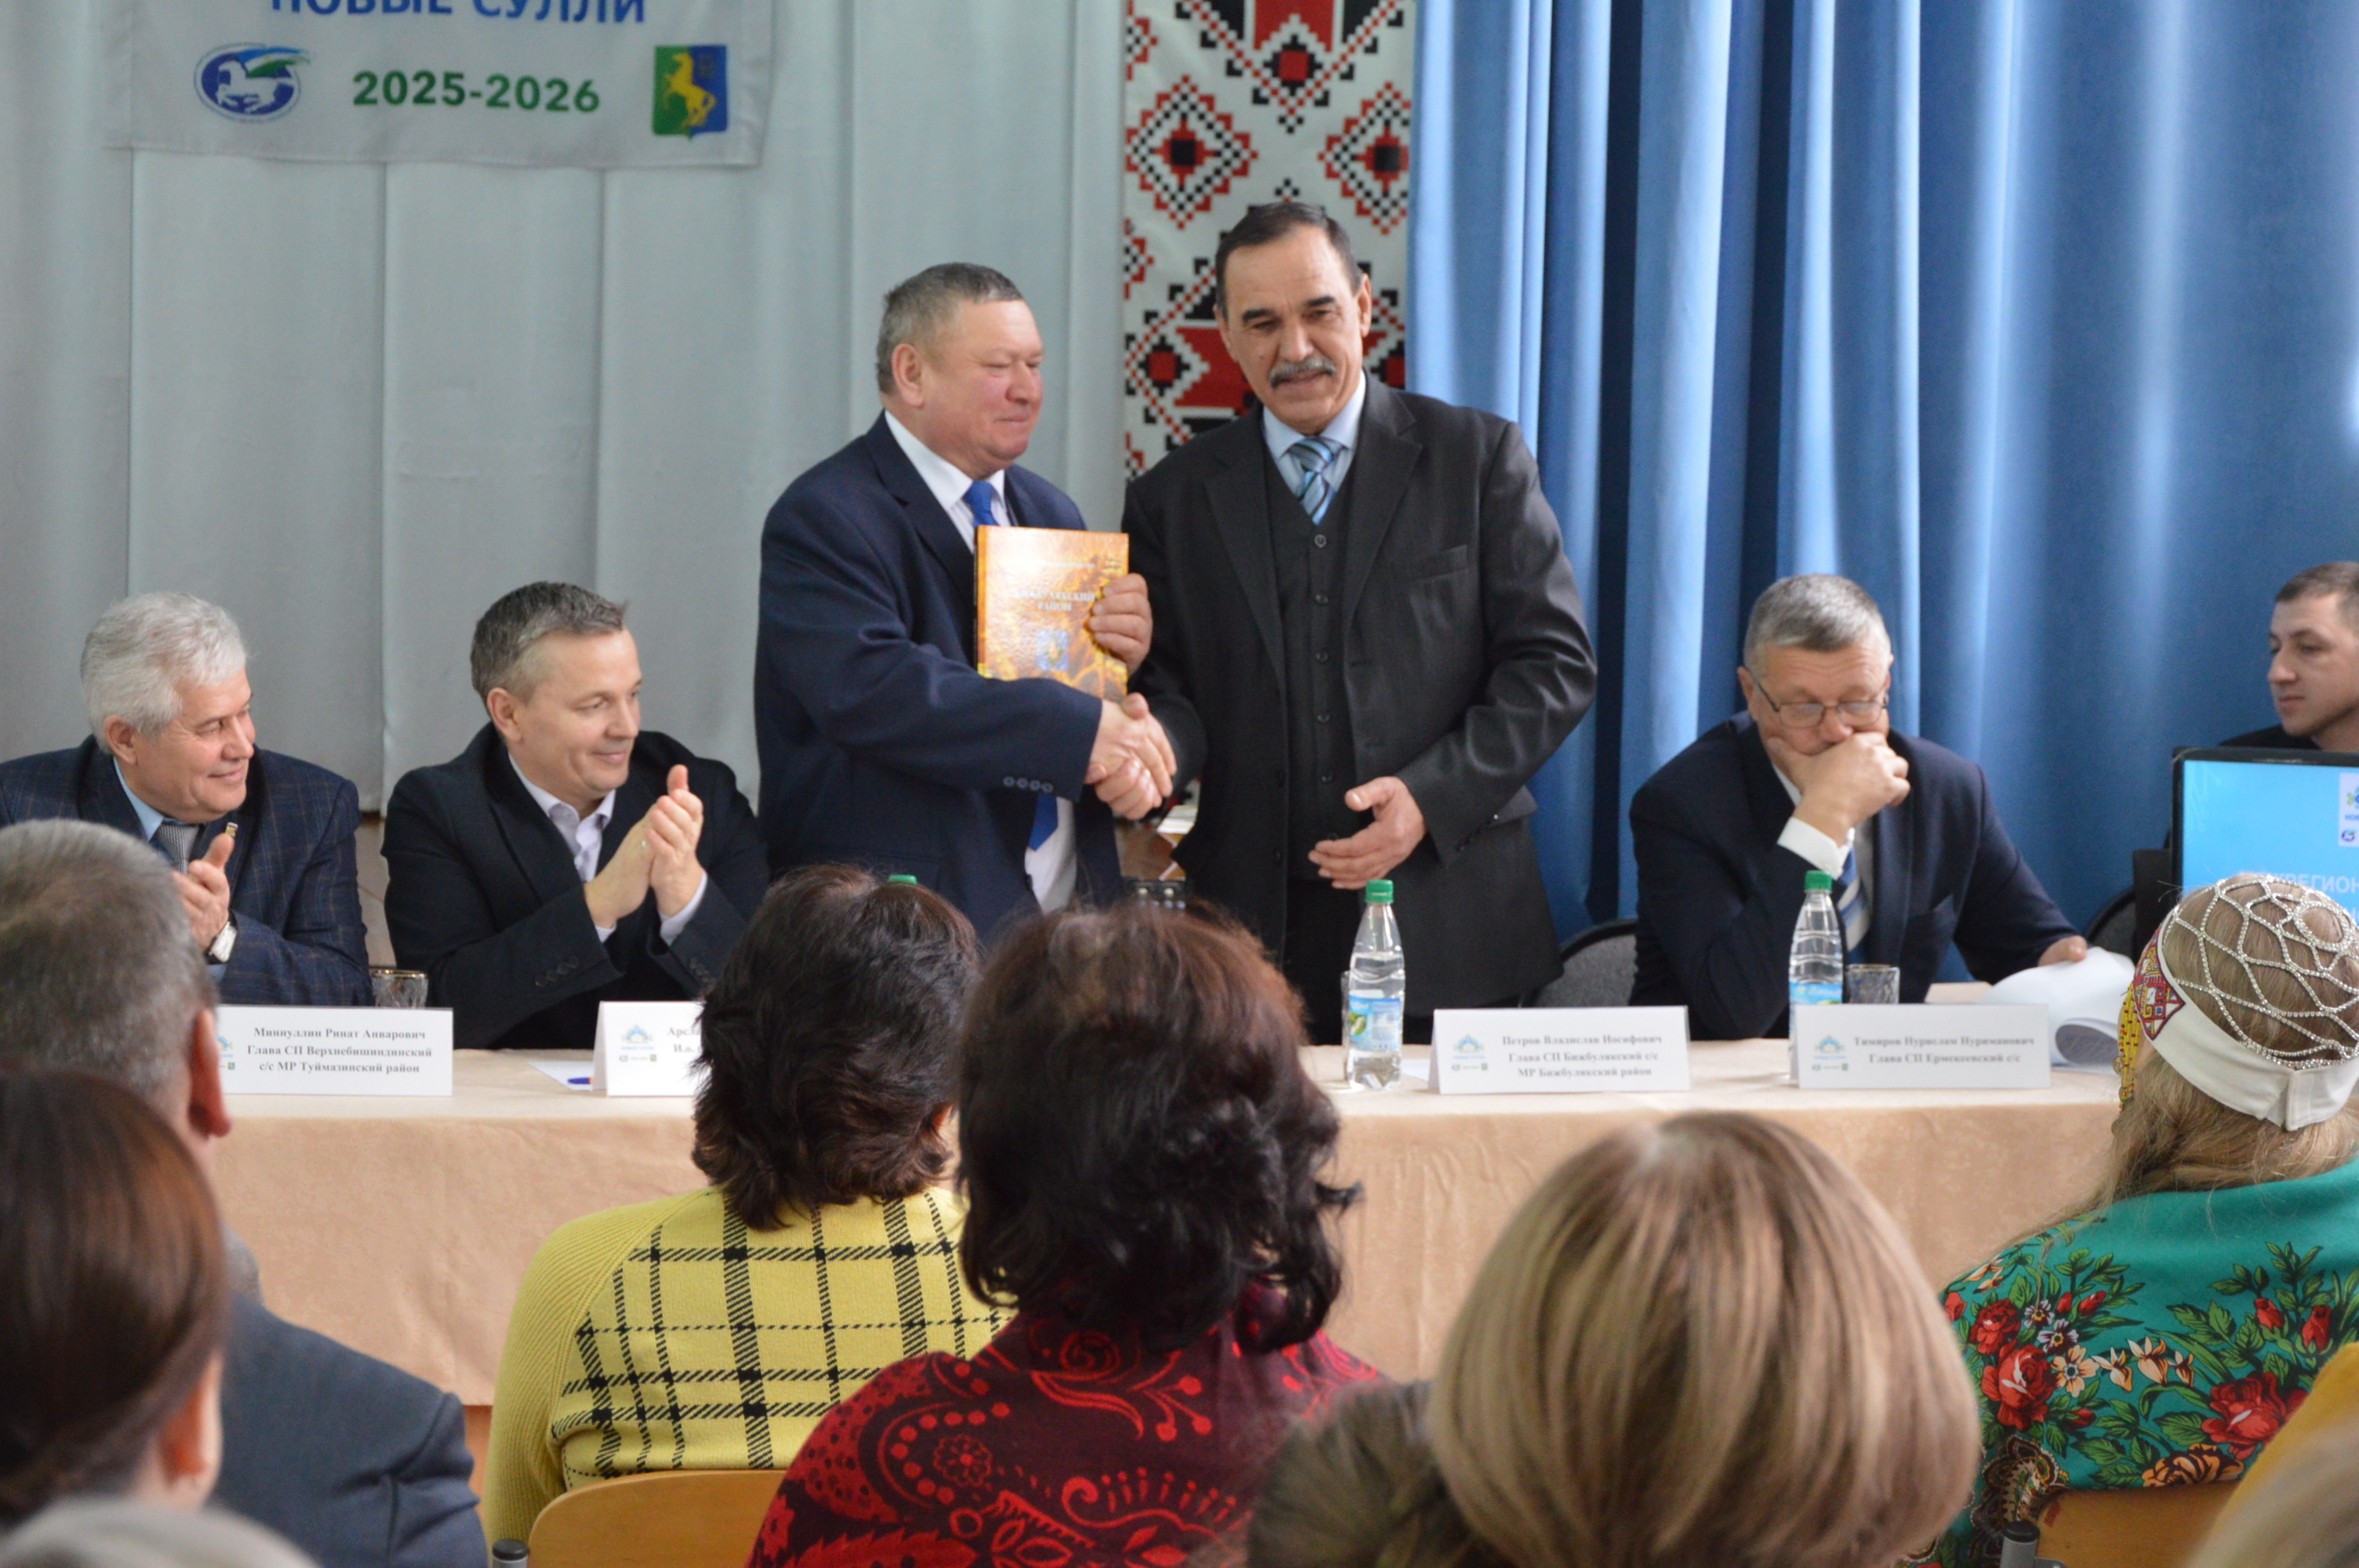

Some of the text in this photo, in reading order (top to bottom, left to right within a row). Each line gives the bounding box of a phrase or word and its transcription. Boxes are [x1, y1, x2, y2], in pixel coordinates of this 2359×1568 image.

[353, 71, 600, 113] 2025-2026
[325, 1029, 358, 1038] Ринат
[363, 1030, 426, 1041] Анварович
[1503, 1034, 1662, 1047] Петров Владислав Иосифович
[247, 1045, 281, 1055] Глава
[285, 1046, 303, 1055] СП
[1509, 1053, 1540, 1062] Глава
[1543, 1053, 1560, 1062] СП
[1870, 1054, 1902, 1063] Глава
[1905, 1054, 1922, 1062] СП
[259, 1062, 420, 1075] с/с МР Туймазинский район
[1518, 1069, 1536, 1077] МР
[1620, 1067, 1652, 1078] район
